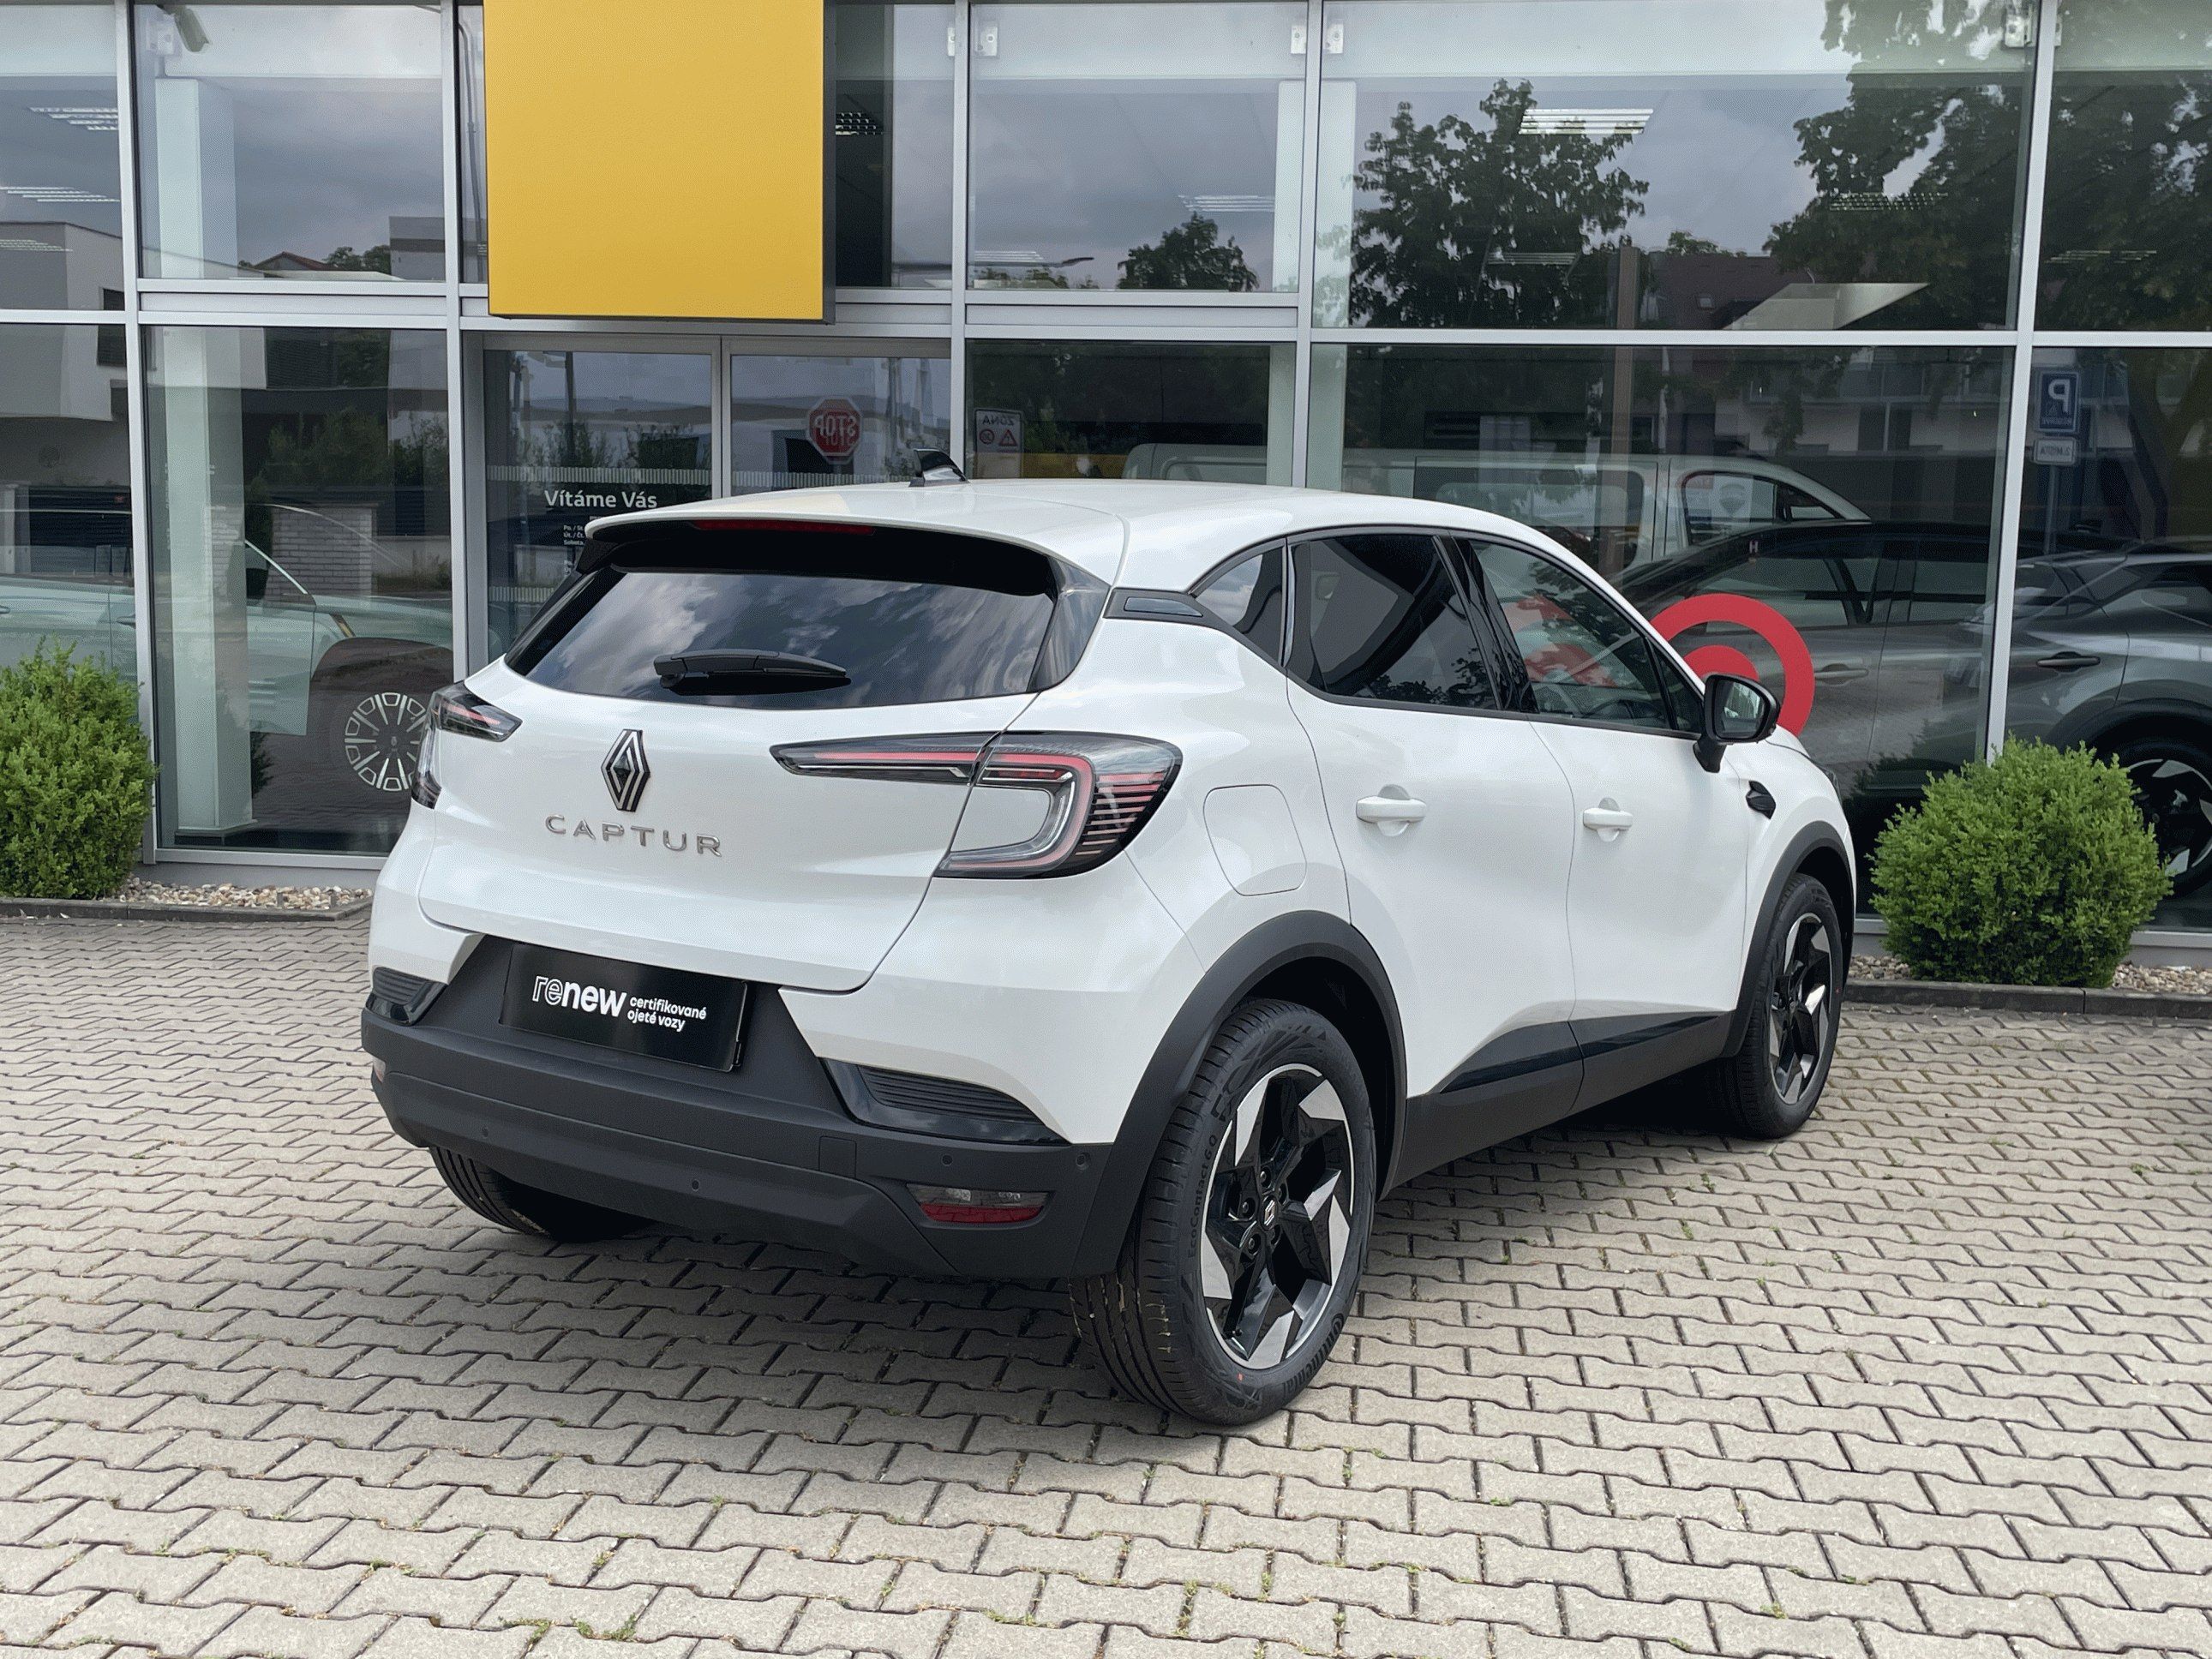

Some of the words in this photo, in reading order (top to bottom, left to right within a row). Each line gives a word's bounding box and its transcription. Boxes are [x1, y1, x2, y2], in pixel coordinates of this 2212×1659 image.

[544, 489, 617, 507] Vítáme
[621, 491, 658, 508] Vás
[544, 814, 722, 857] CAPTUR
[532, 975, 627, 1017] renew
[629, 996, 707, 1020] certifikované
[626, 1009, 656, 1025] ojeté
[658, 1015, 686, 1033] vozy
[1188, 1163, 1209, 1259] EcoContact
